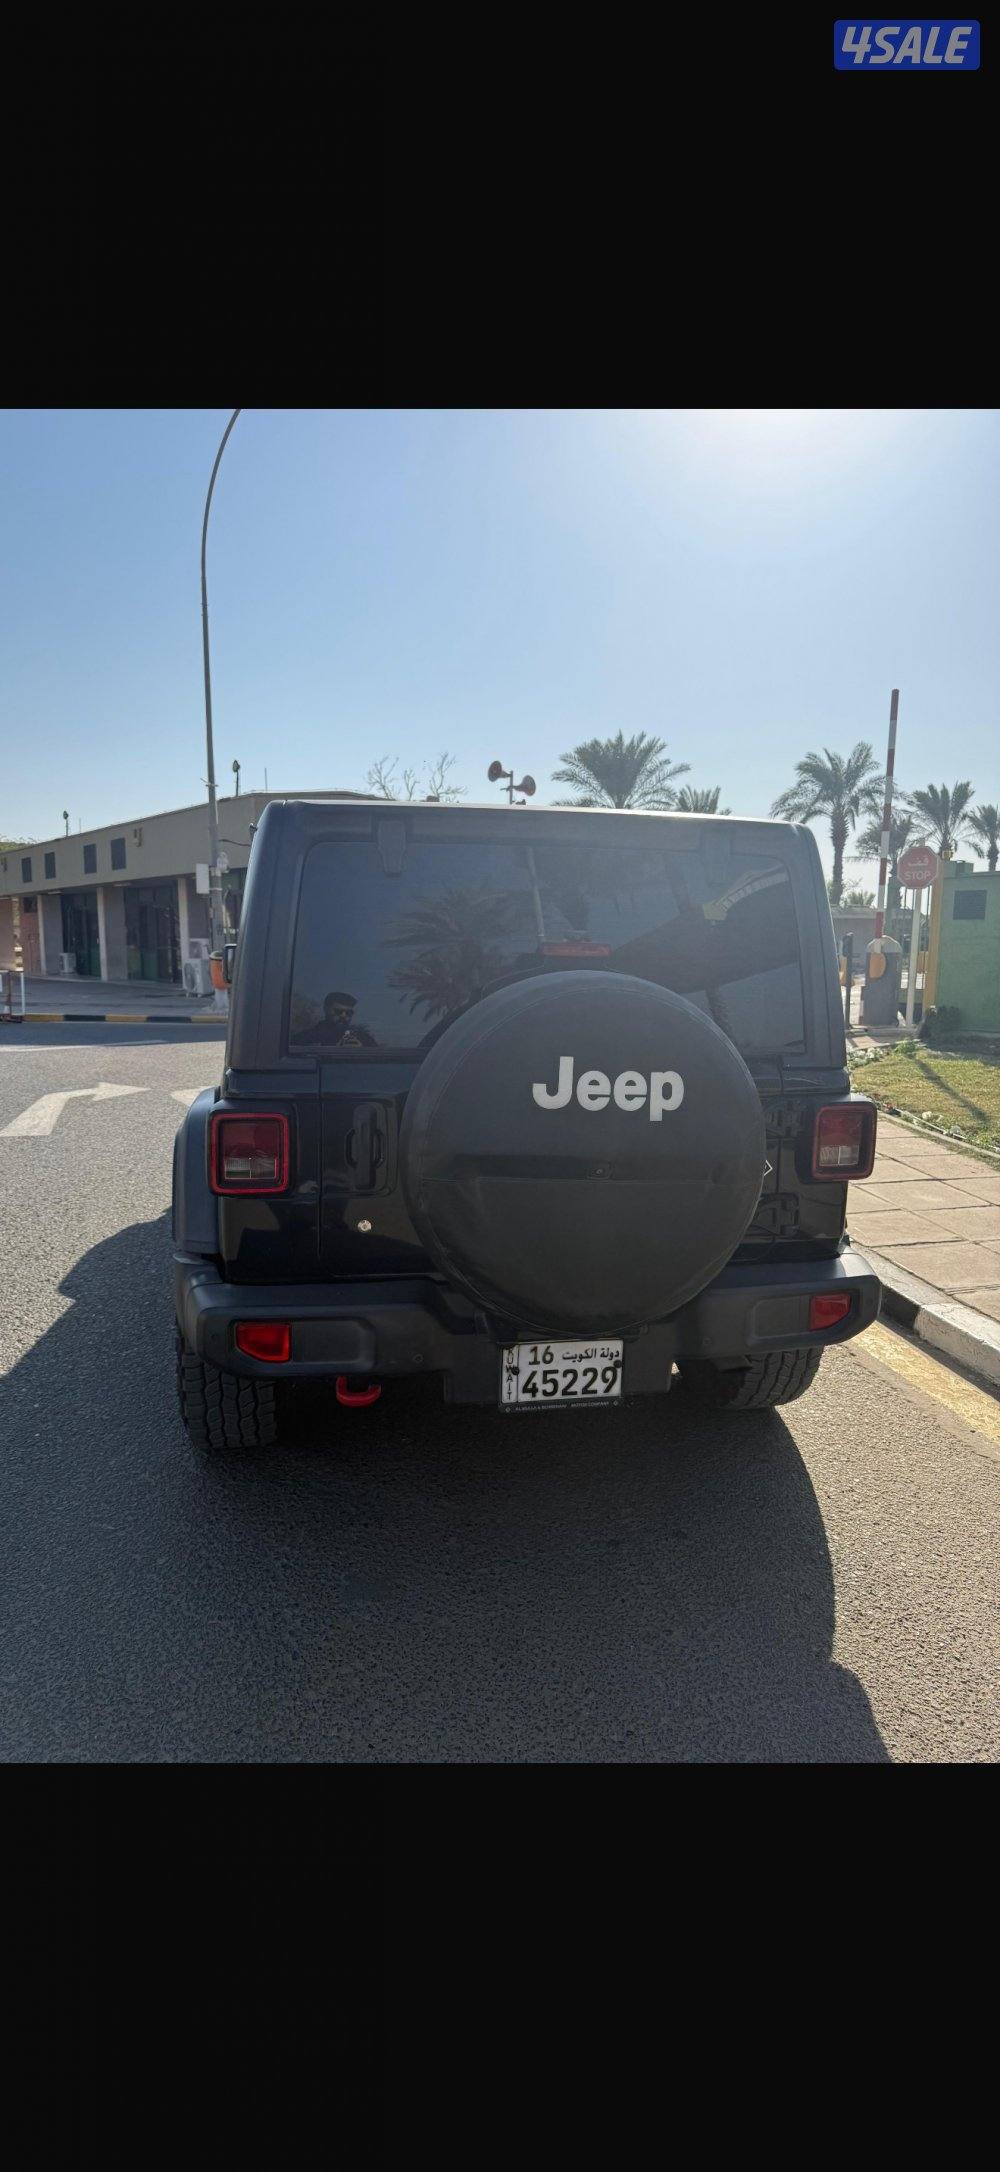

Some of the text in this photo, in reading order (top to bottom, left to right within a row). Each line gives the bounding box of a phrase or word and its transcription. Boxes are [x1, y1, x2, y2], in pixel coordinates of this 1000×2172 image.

[904, 870, 932, 880] STOP
[532, 1056, 685, 1122] Jeep
[528, 1345, 554, 1366] 16
[562, 1347, 620, 1363] دولة الكويت
[522, 1366, 618, 1398] 45229
